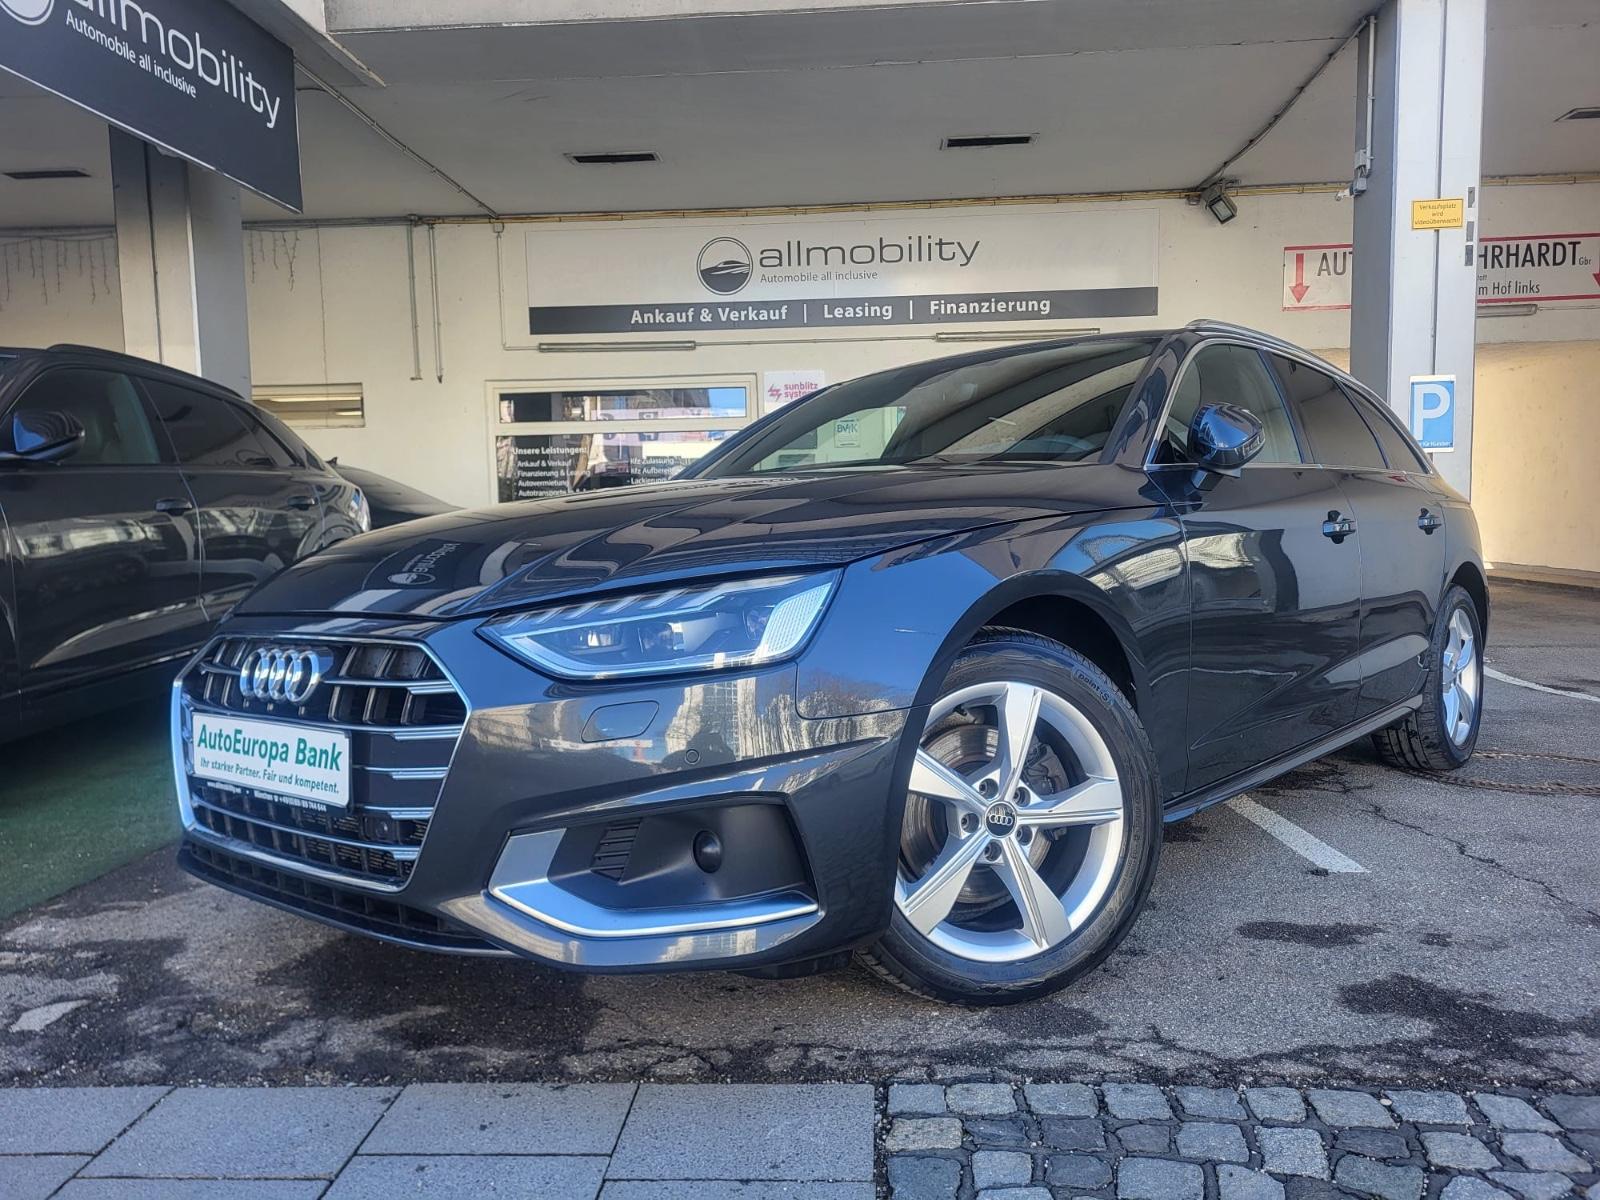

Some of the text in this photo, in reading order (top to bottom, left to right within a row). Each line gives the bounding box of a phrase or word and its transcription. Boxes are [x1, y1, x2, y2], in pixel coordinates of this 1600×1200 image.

[66, 9, 197, 98] Automobile all inclusive
[73, 0, 280, 128] lmobility
[759, 235, 981, 267] allmobility
[1317, 251, 1353, 277] AU
[760, 270, 878, 283] Automobile all inclusive
[1492, 281, 1512, 295] Hof
[1514, 280, 1540, 294] links
[630, 298, 1051, 324] Ankauf & Verkauf Leasing Finanzierung
[784, 382, 818, 390] sunblitz
[1413, 383, 1450, 440] P
[513, 447, 540, 455] Unsere
[547, 459, 572, 467] Verkauf
[517, 470, 558, 478] Finanzierung
[631, 467, 641, 475] Kfz
[197, 723, 343, 772] AutoEuropa Bank
[200, 756, 340, 794] Ihr starker Partner. Fair und kompetent.
